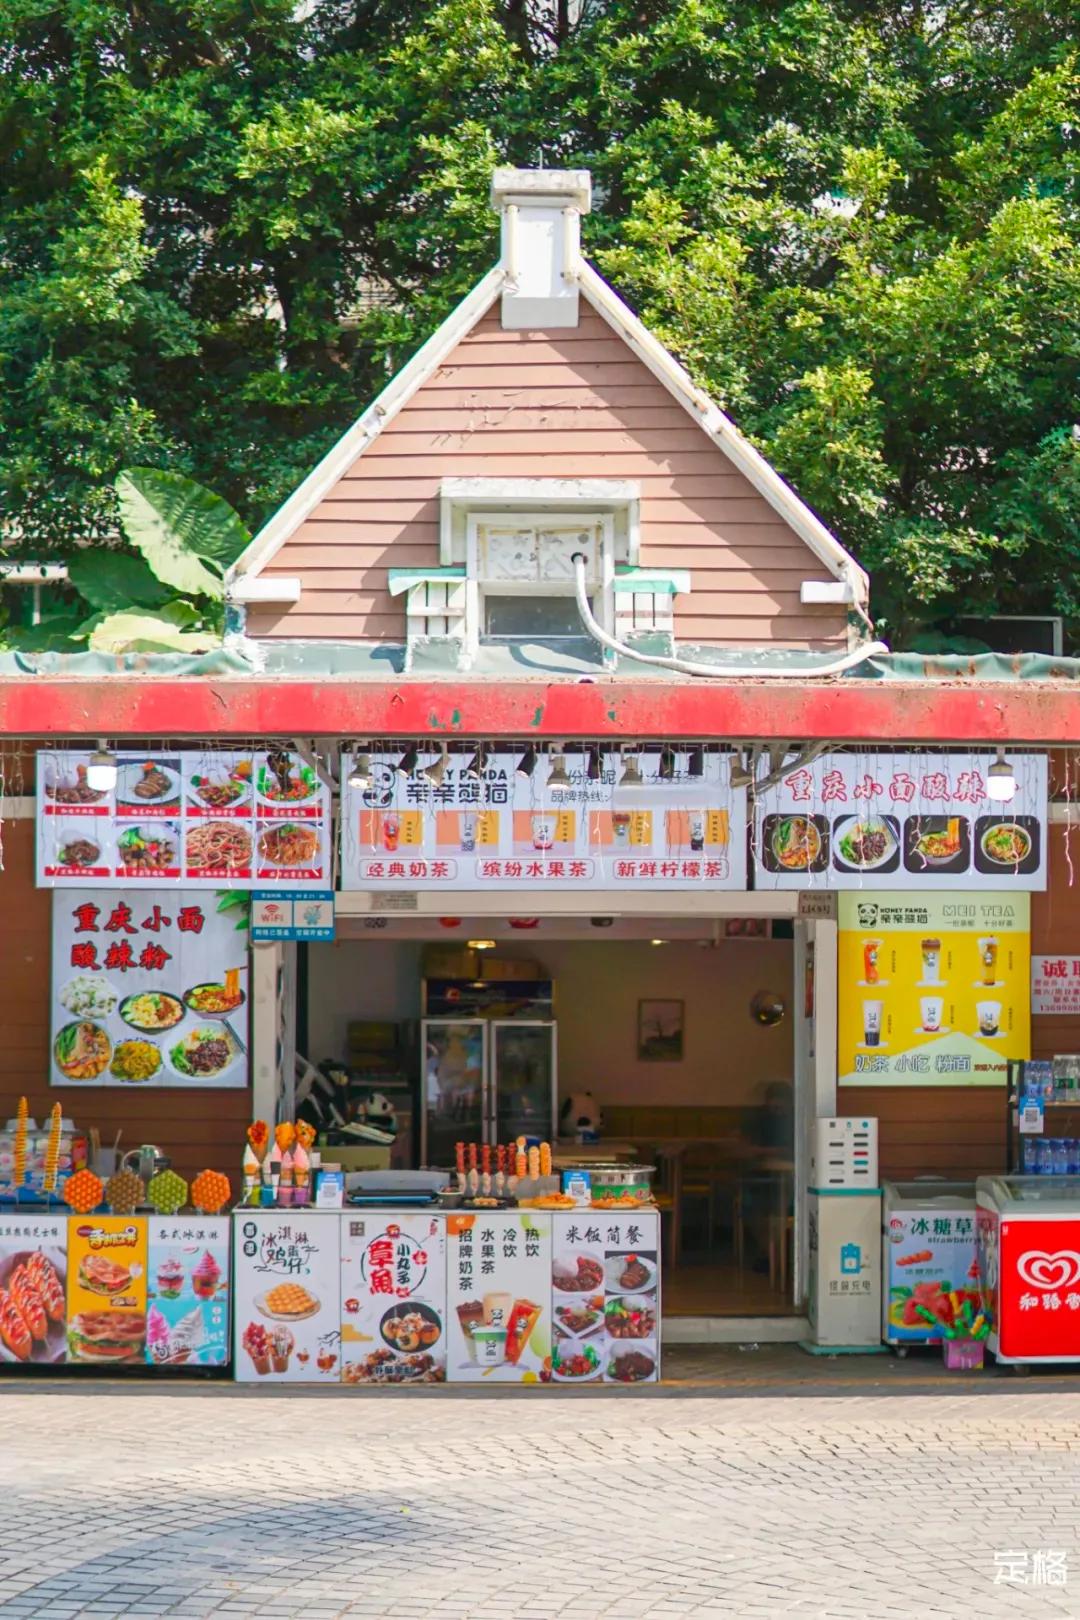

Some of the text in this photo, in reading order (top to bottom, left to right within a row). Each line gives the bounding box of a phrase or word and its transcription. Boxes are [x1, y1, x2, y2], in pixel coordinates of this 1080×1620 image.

[785, 769, 1019, 803] 重庆小面酸辣
[366, 862, 448, 877] 经典奶茶
[482, 861, 587, 877] 缤纷水果茶
[617, 861, 722, 878] 新鲜柠檬茶
[72, 901, 205, 934] 重庆小面
[942, 904, 1015, 917] MEI TEA
[70, 939, 172, 972] 酸辣粉
[855, 1054, 971, 1073] 奶茶 小吃 粉面
[262, 1226, 309, 1248] 冰淇淋
[502, 1228, 518, 1258] 冷饮
[525, 1228, 540, 1258] 热饮
[565, 1225, 644, 1245] 米饭简餐
[266, 1245, 303, 1274] 鸡蛋仔
[397, 1243, 410, 1284] 小丸子
[458, 1228, 473, 1291] 招牌奶茶
[480, 1228, 495, 1275] 水果茶
